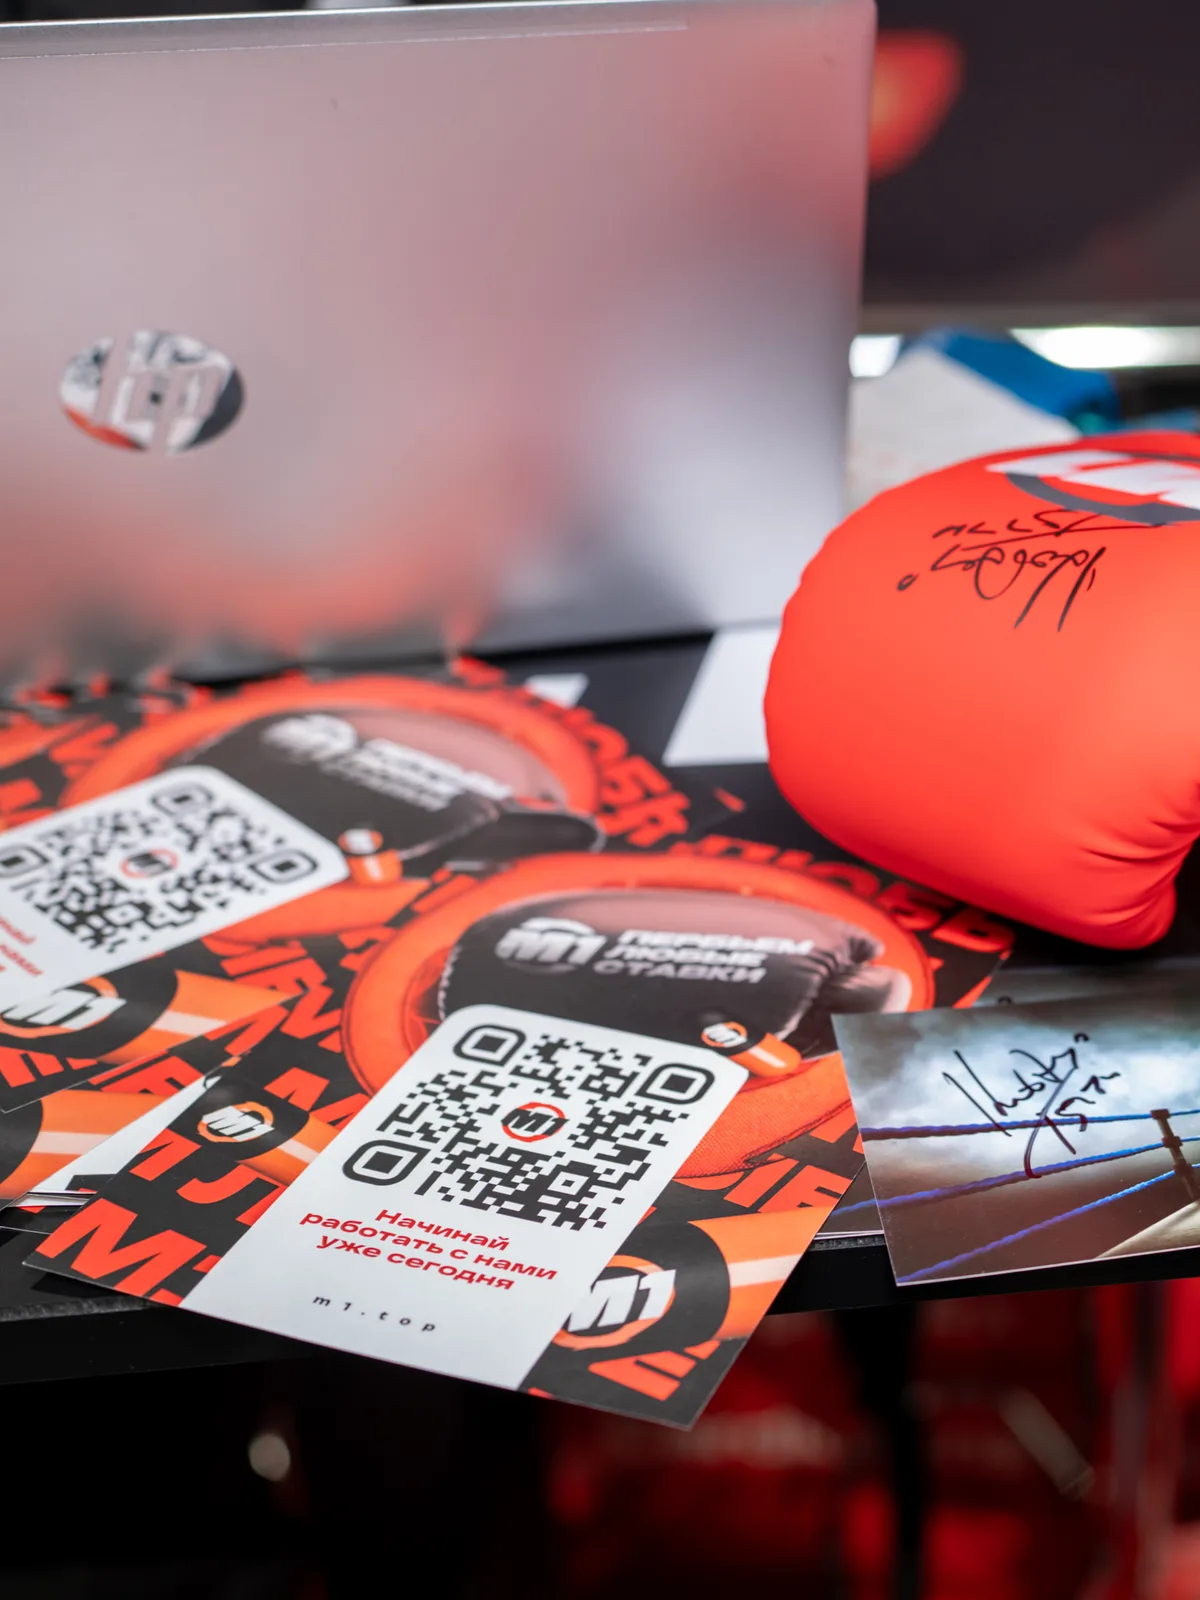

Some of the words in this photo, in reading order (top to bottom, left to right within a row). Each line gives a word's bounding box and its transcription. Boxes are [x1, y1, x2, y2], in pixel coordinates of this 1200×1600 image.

[495, 922, 606, 968] M1
[593, 960, 767, 984] СТАВКИ
[202, 1105, 276, 1142] M1
[501, 1107, 570, 1137] M1
[299, 1212, 443, 1255] работать
[449, 1248, 469, 1261] с
[474, 1253, 558, 1281] нами
[375, 1208, 510, 1251] Начинай
[316, 1234, 382, 1259] уже
[387, 1253, 515, 1291] сегодня
